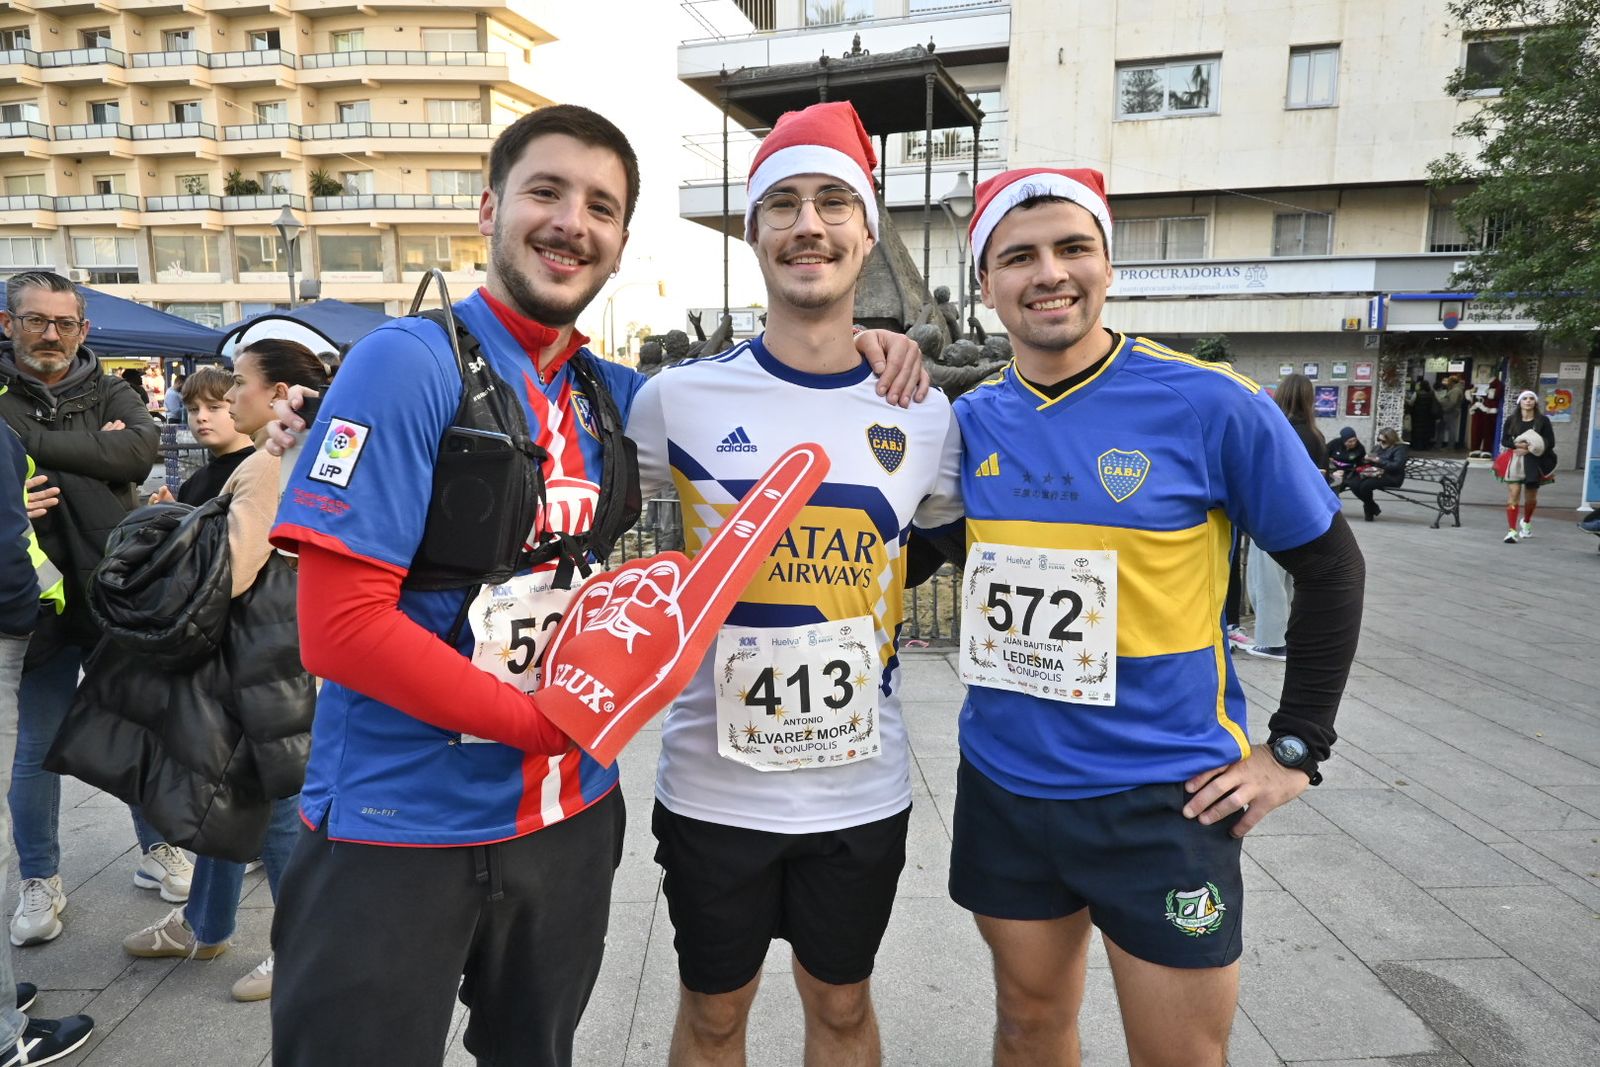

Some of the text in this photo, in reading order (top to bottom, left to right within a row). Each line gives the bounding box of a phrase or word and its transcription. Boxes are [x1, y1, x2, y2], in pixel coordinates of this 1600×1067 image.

[1120, 267, 1240, 280] PROCURADORAS
[716, 443, 758, 453] adidas
[873, 438, 903, 451] CABJ
[319, 463, 342, 478] LFP
[1103, 466, 1142, 478] CABJ
[770, 526, 877, 565] ATAR
[768, 561, 872, 588] AIRWAYS
[987, 582, 1083, 642] 572
[772, 637, 800, 647] Huelva
[1003, 637, 1064, 653] JUAN BAUTISTA
[1003, 650, 1065, 671] LEDESMA
[1015, 666, 1062, 683] ONUPOLIS
[745, 659, 854, 716] 413
[783, 715, 824, 726] ANTONIO
[747, 723, 857, 744] ALVAREZ MORA
[784, 741, 838, 754] ONUPOLIS
[361, 807, 397, 817] DRI-FIT
